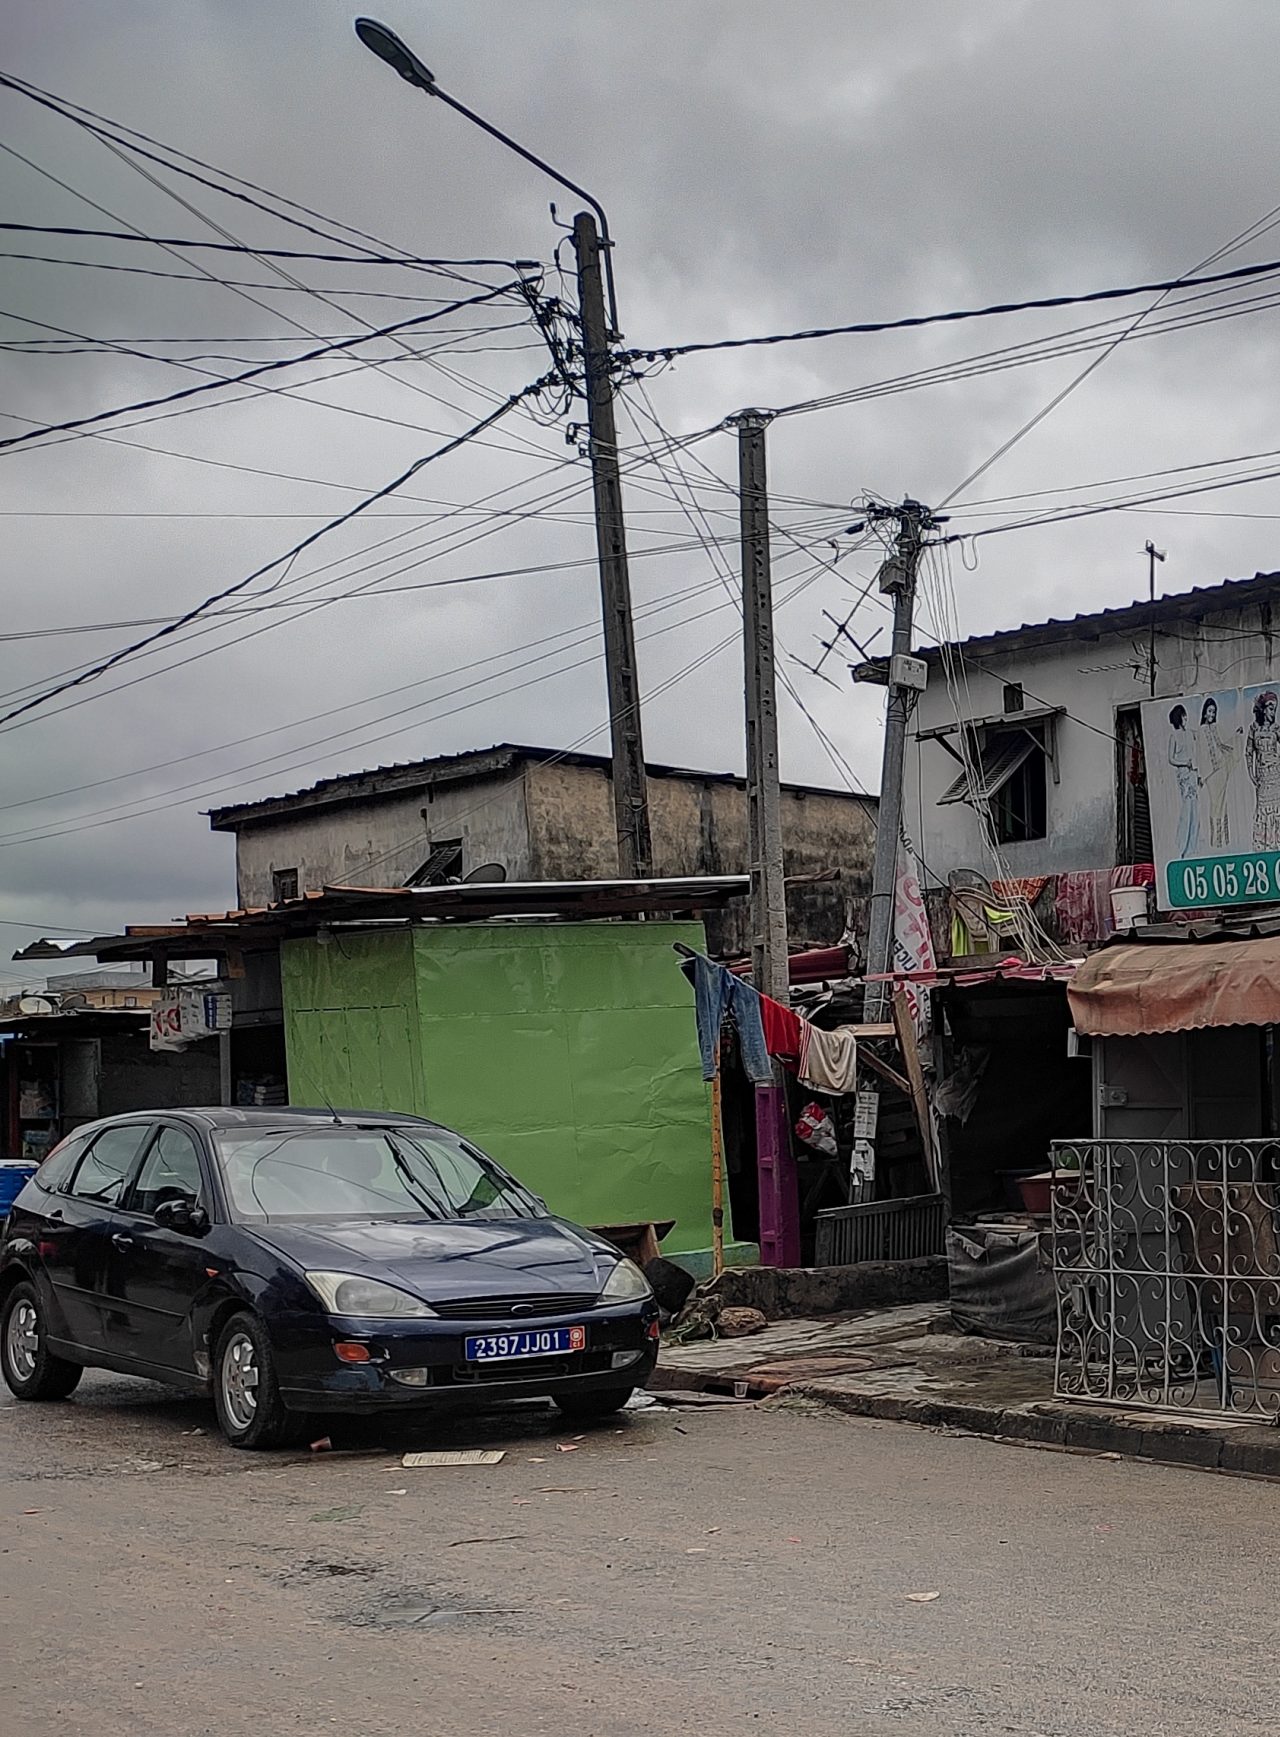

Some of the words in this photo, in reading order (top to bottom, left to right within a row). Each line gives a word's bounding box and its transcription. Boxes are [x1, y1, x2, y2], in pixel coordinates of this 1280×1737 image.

[1183, 866, 1208, 900] 05
[1213, 863, 1239, 897] 05
[1243, 860, 1270, 895] 28
